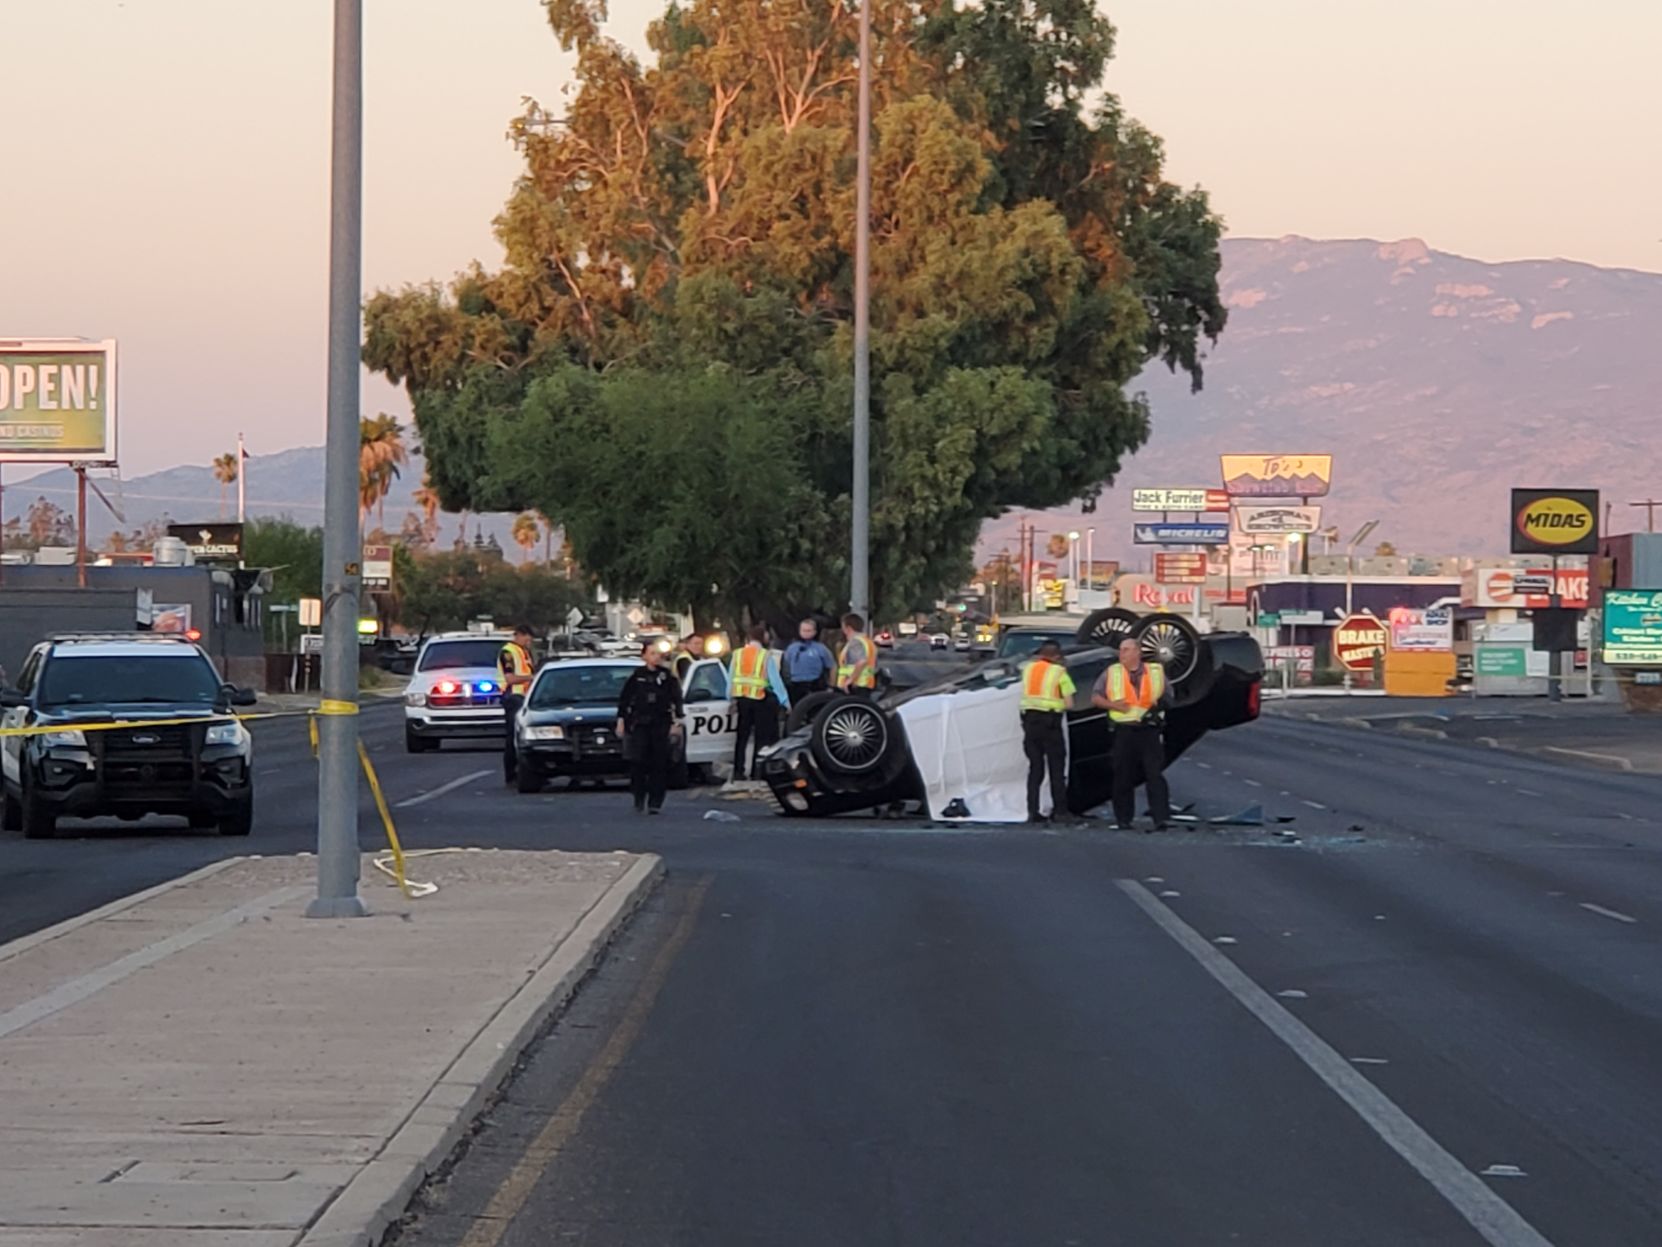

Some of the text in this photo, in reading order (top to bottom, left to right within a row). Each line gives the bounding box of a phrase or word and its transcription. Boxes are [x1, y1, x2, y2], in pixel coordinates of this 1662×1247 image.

[1133, 490, 1204, 503] Jack Furrier
[1524, 506, 1588, 529] MIDAS
[1338, 629, 1385, 645] BRAKE
[691, 714, 738, 736] POL
